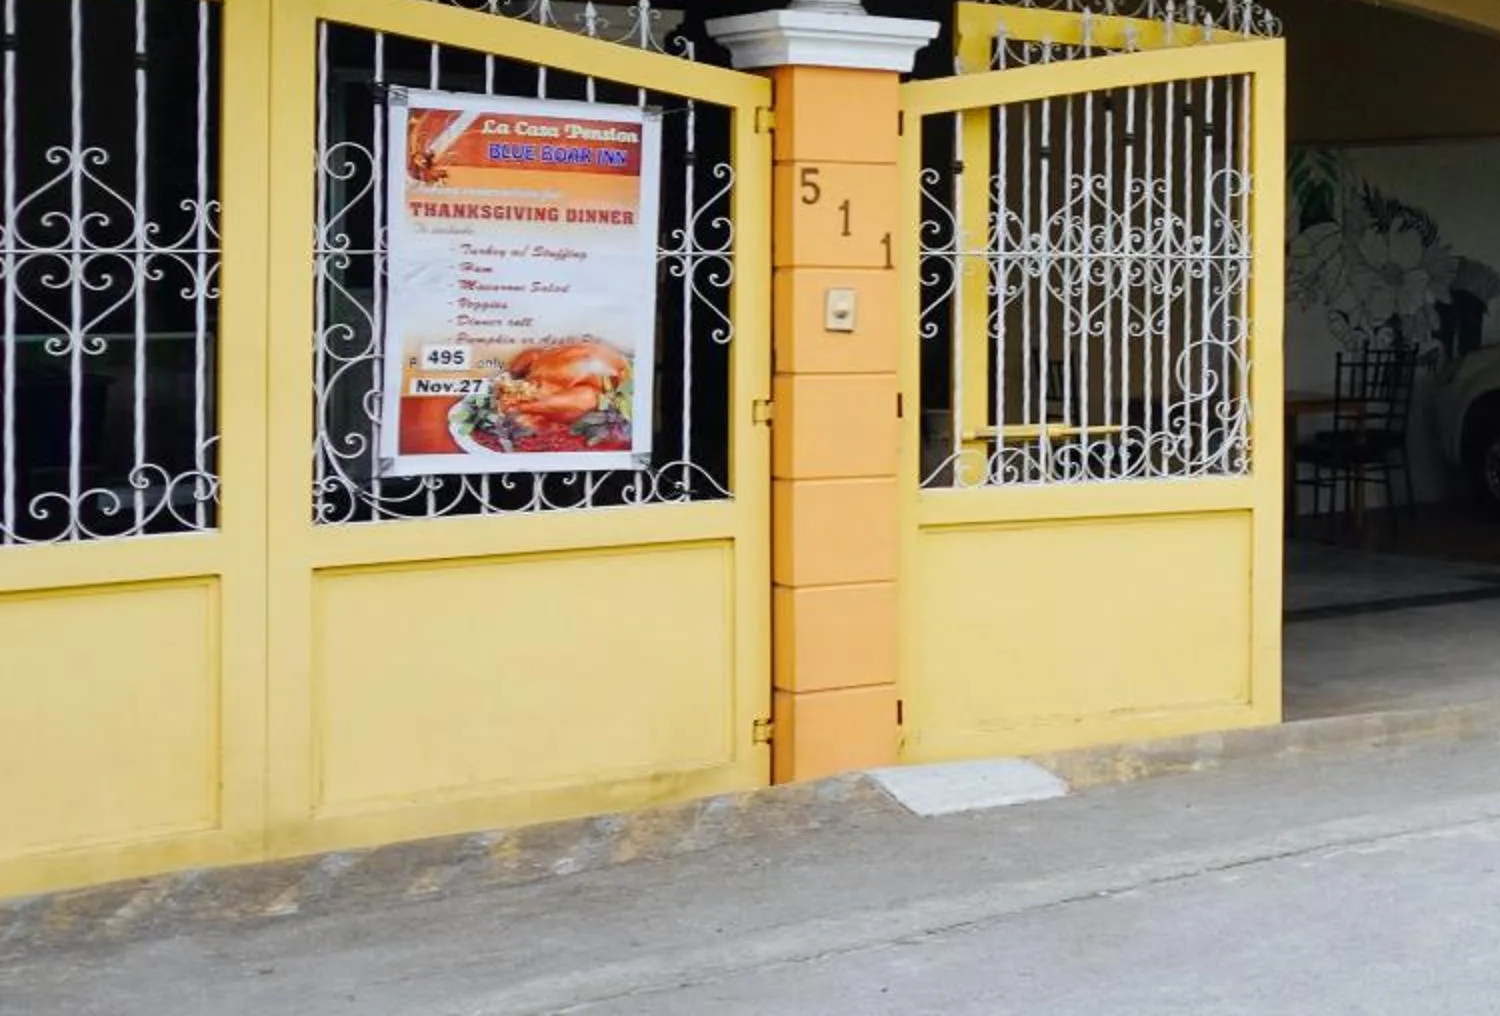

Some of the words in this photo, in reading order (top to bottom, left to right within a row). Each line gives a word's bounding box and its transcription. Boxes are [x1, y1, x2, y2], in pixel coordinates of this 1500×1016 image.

[482, 120, 509, 134] La
[513, 121, 559, 138] Casa
[564, 124, 640, 143] Pension
[489, 143, 536, 160] BLUE
[541, 146, 592, 164] BOAR
[597, 150, 628, 166] INN
[409, 201, 559, 222] THANKSGIVING
[566, 209, 634, 225] DINNER
[460, 243, 506, 257] Turkey
[427, 350, 465, 365] 495
[416, 379, 483, 394] Nov.27
